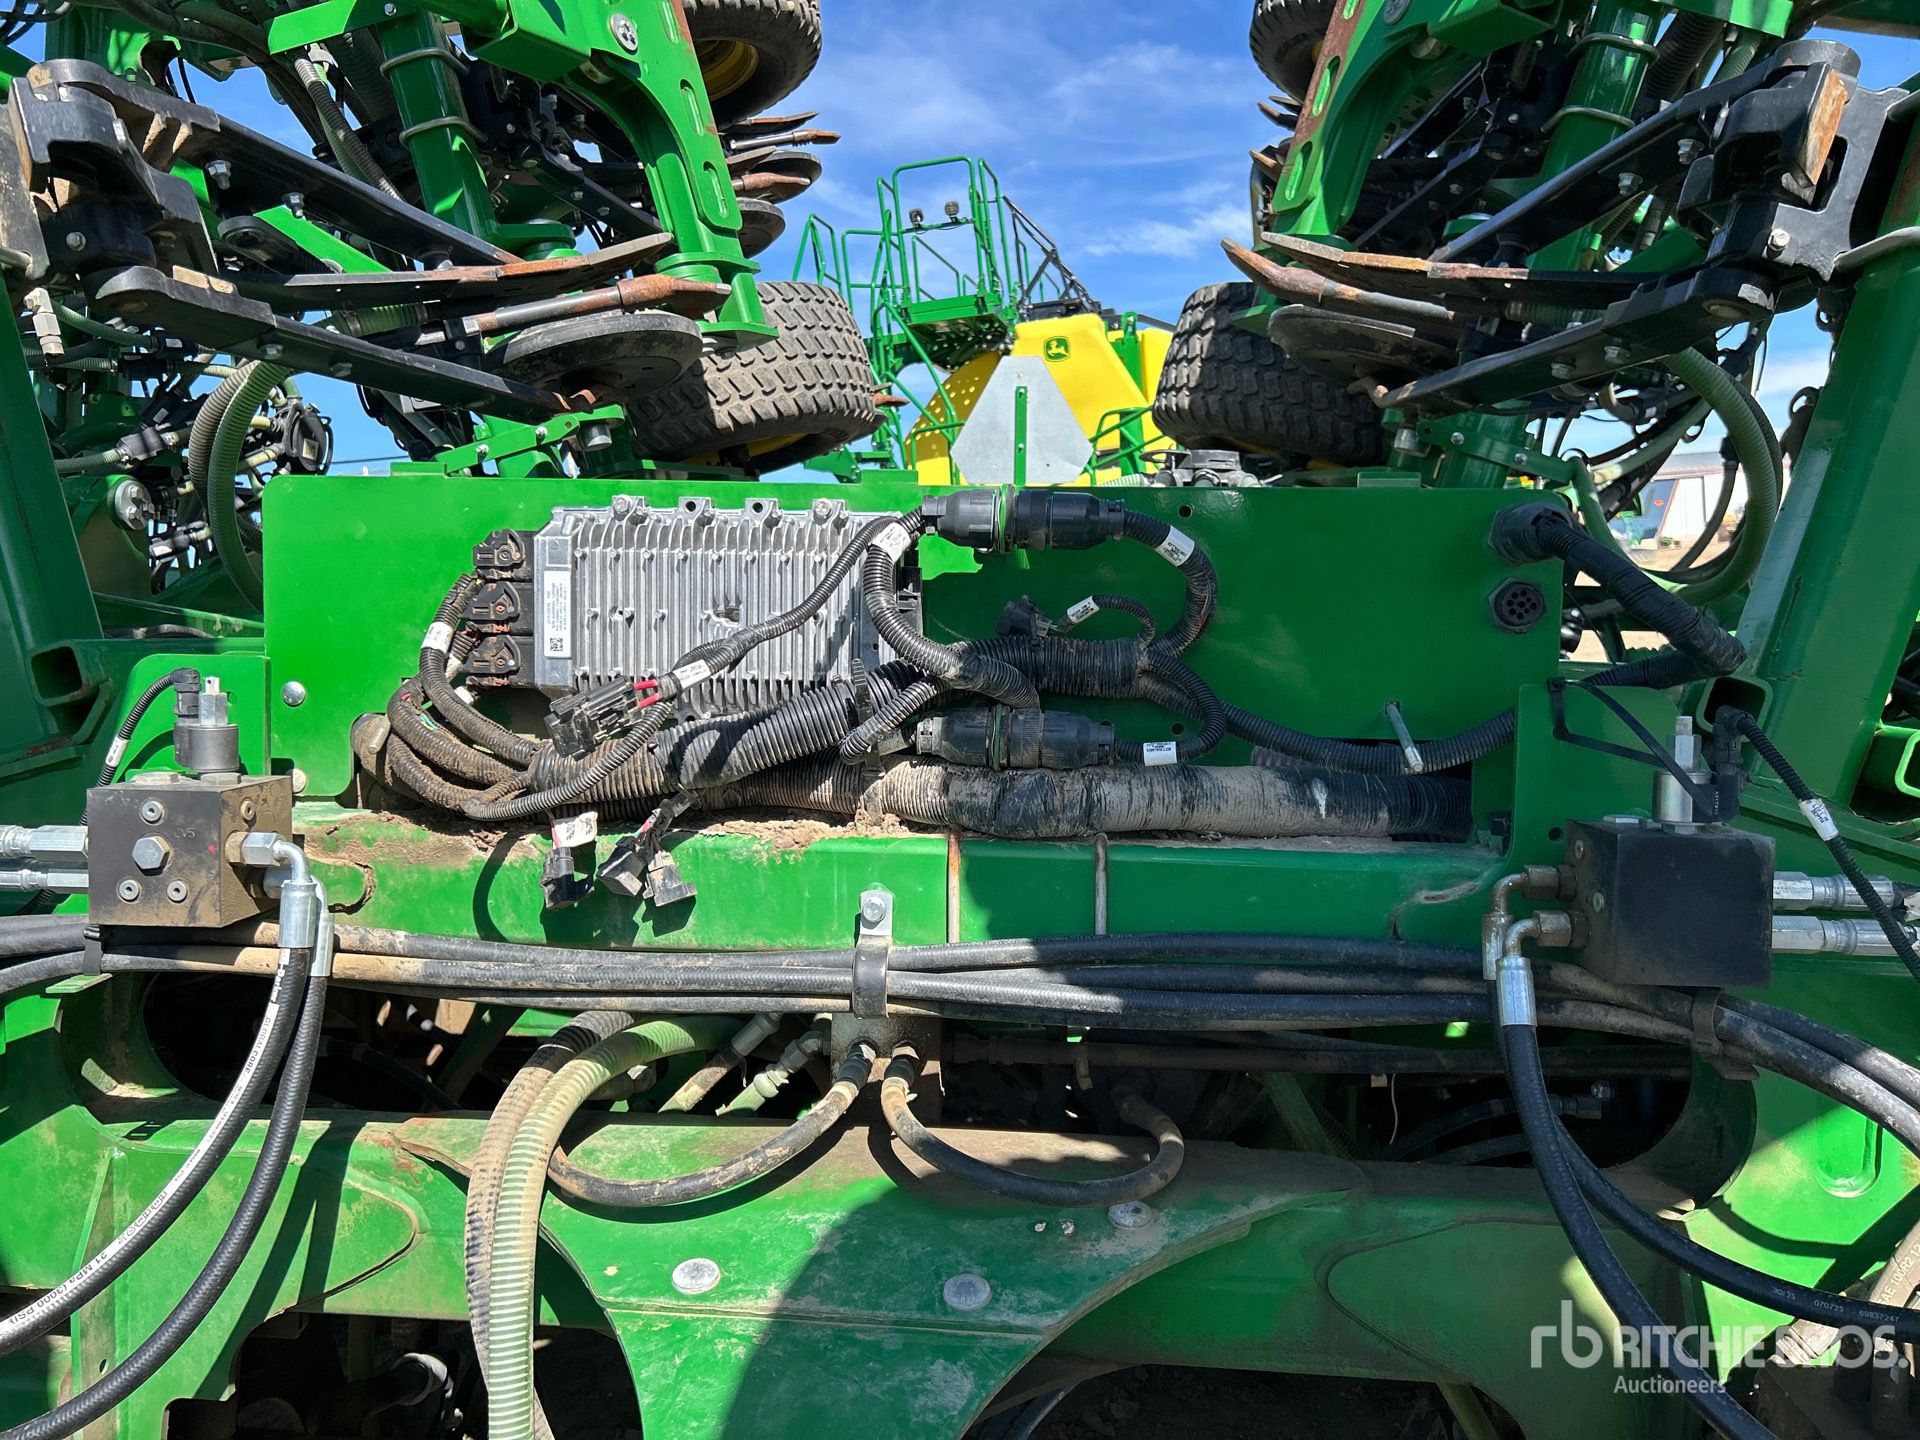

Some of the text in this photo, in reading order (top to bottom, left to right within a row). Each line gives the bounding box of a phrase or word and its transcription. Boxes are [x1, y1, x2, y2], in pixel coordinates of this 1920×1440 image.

[270, 968, 286, 1003] Parker
[1890, 1256, 1915, 1286] 100R2
[9, 1252, 108, 1325] 21 MPa (3000 PSI)
[1813, 1300, 1845, 1313] 070725
